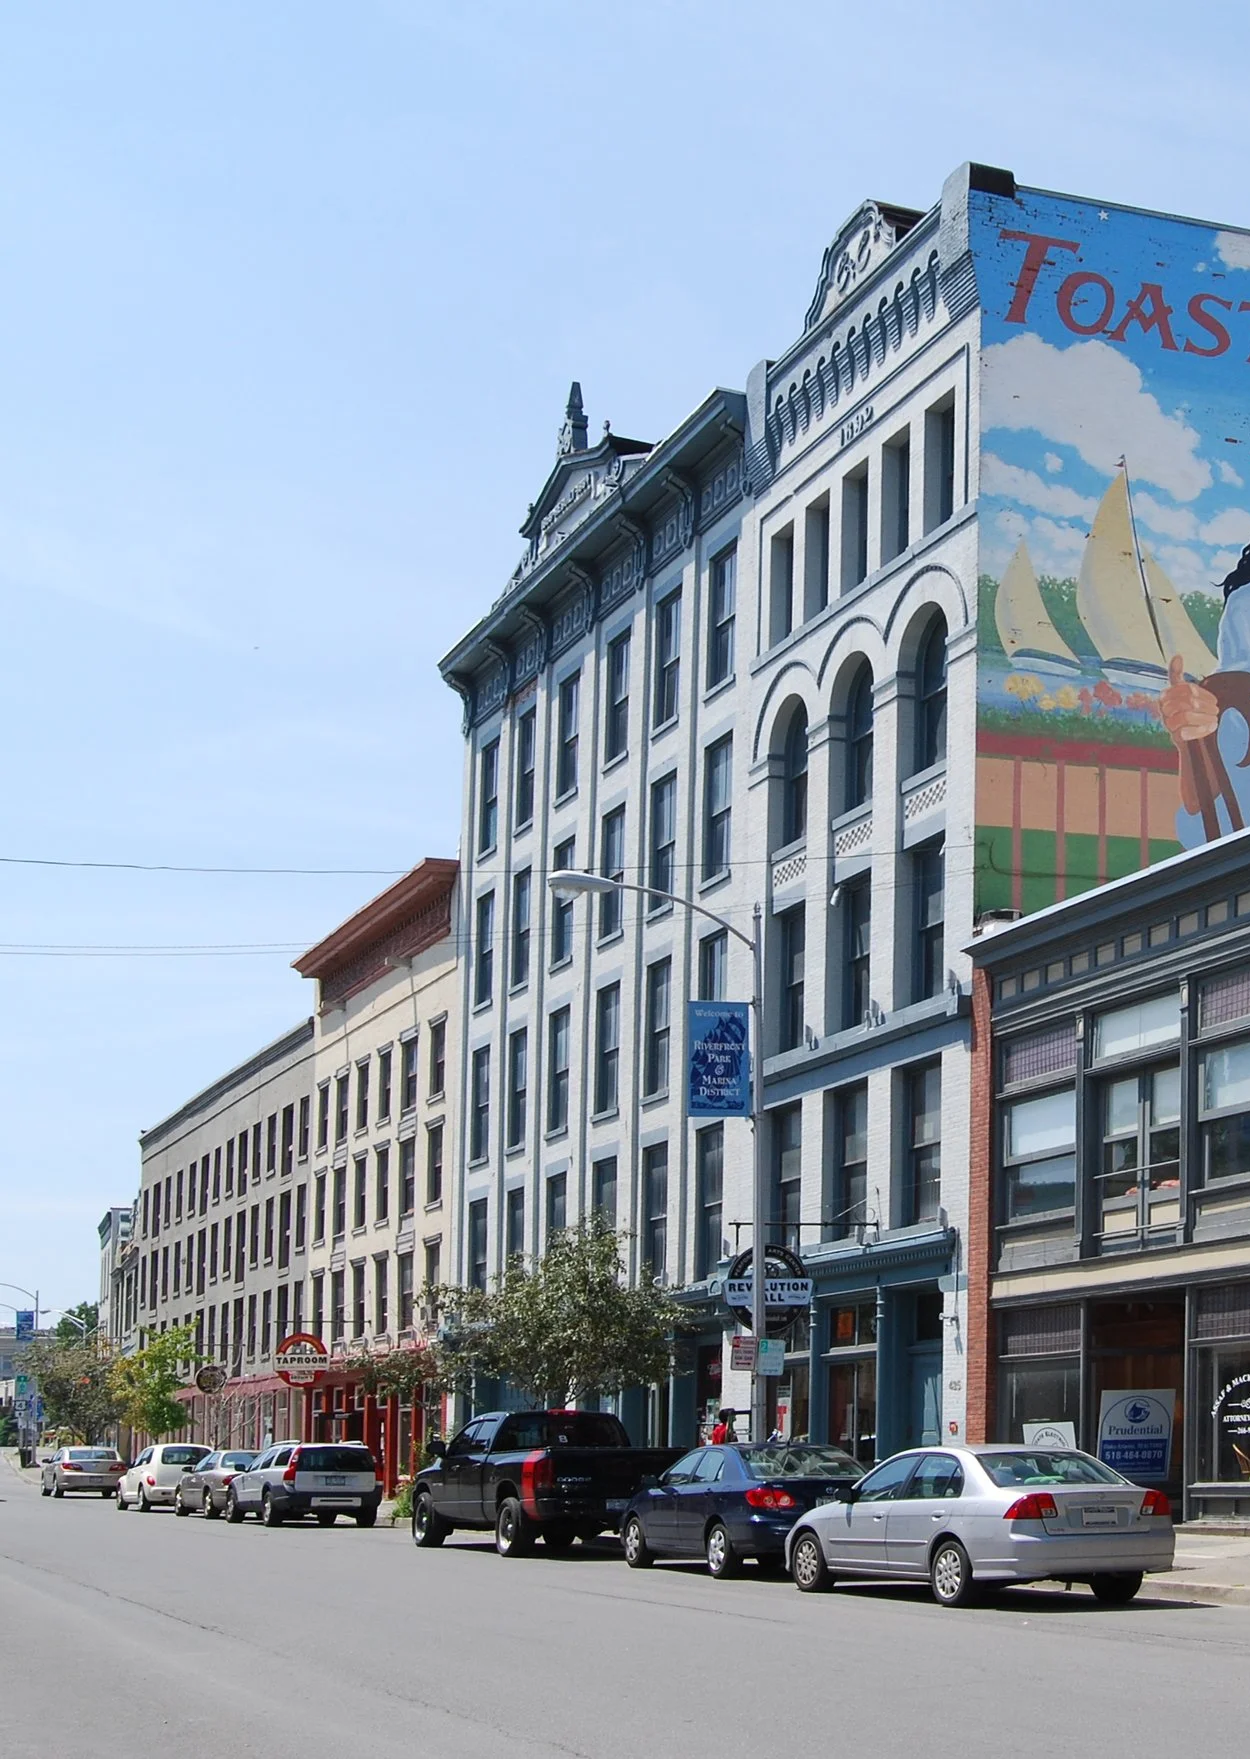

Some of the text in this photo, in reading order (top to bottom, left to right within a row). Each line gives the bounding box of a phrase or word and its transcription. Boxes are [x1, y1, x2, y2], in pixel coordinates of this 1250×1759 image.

[694, 1009, 733, 1017] Welcome
[694, 1040, 746, 1051] RIVERFRONT
[707, 1053, 731, 1063] PARK
[714, 1064, 724, 1075] &
[702, 1075, 737, 1085] MARINA
[699, 1086, 740, 1097] DISTRICT
[728, 1282, 809, 1292] REVUTION
[276, 1356, 328, 1364] TAPROOM
[1108, 1424, 1163, 1435] Prudential
